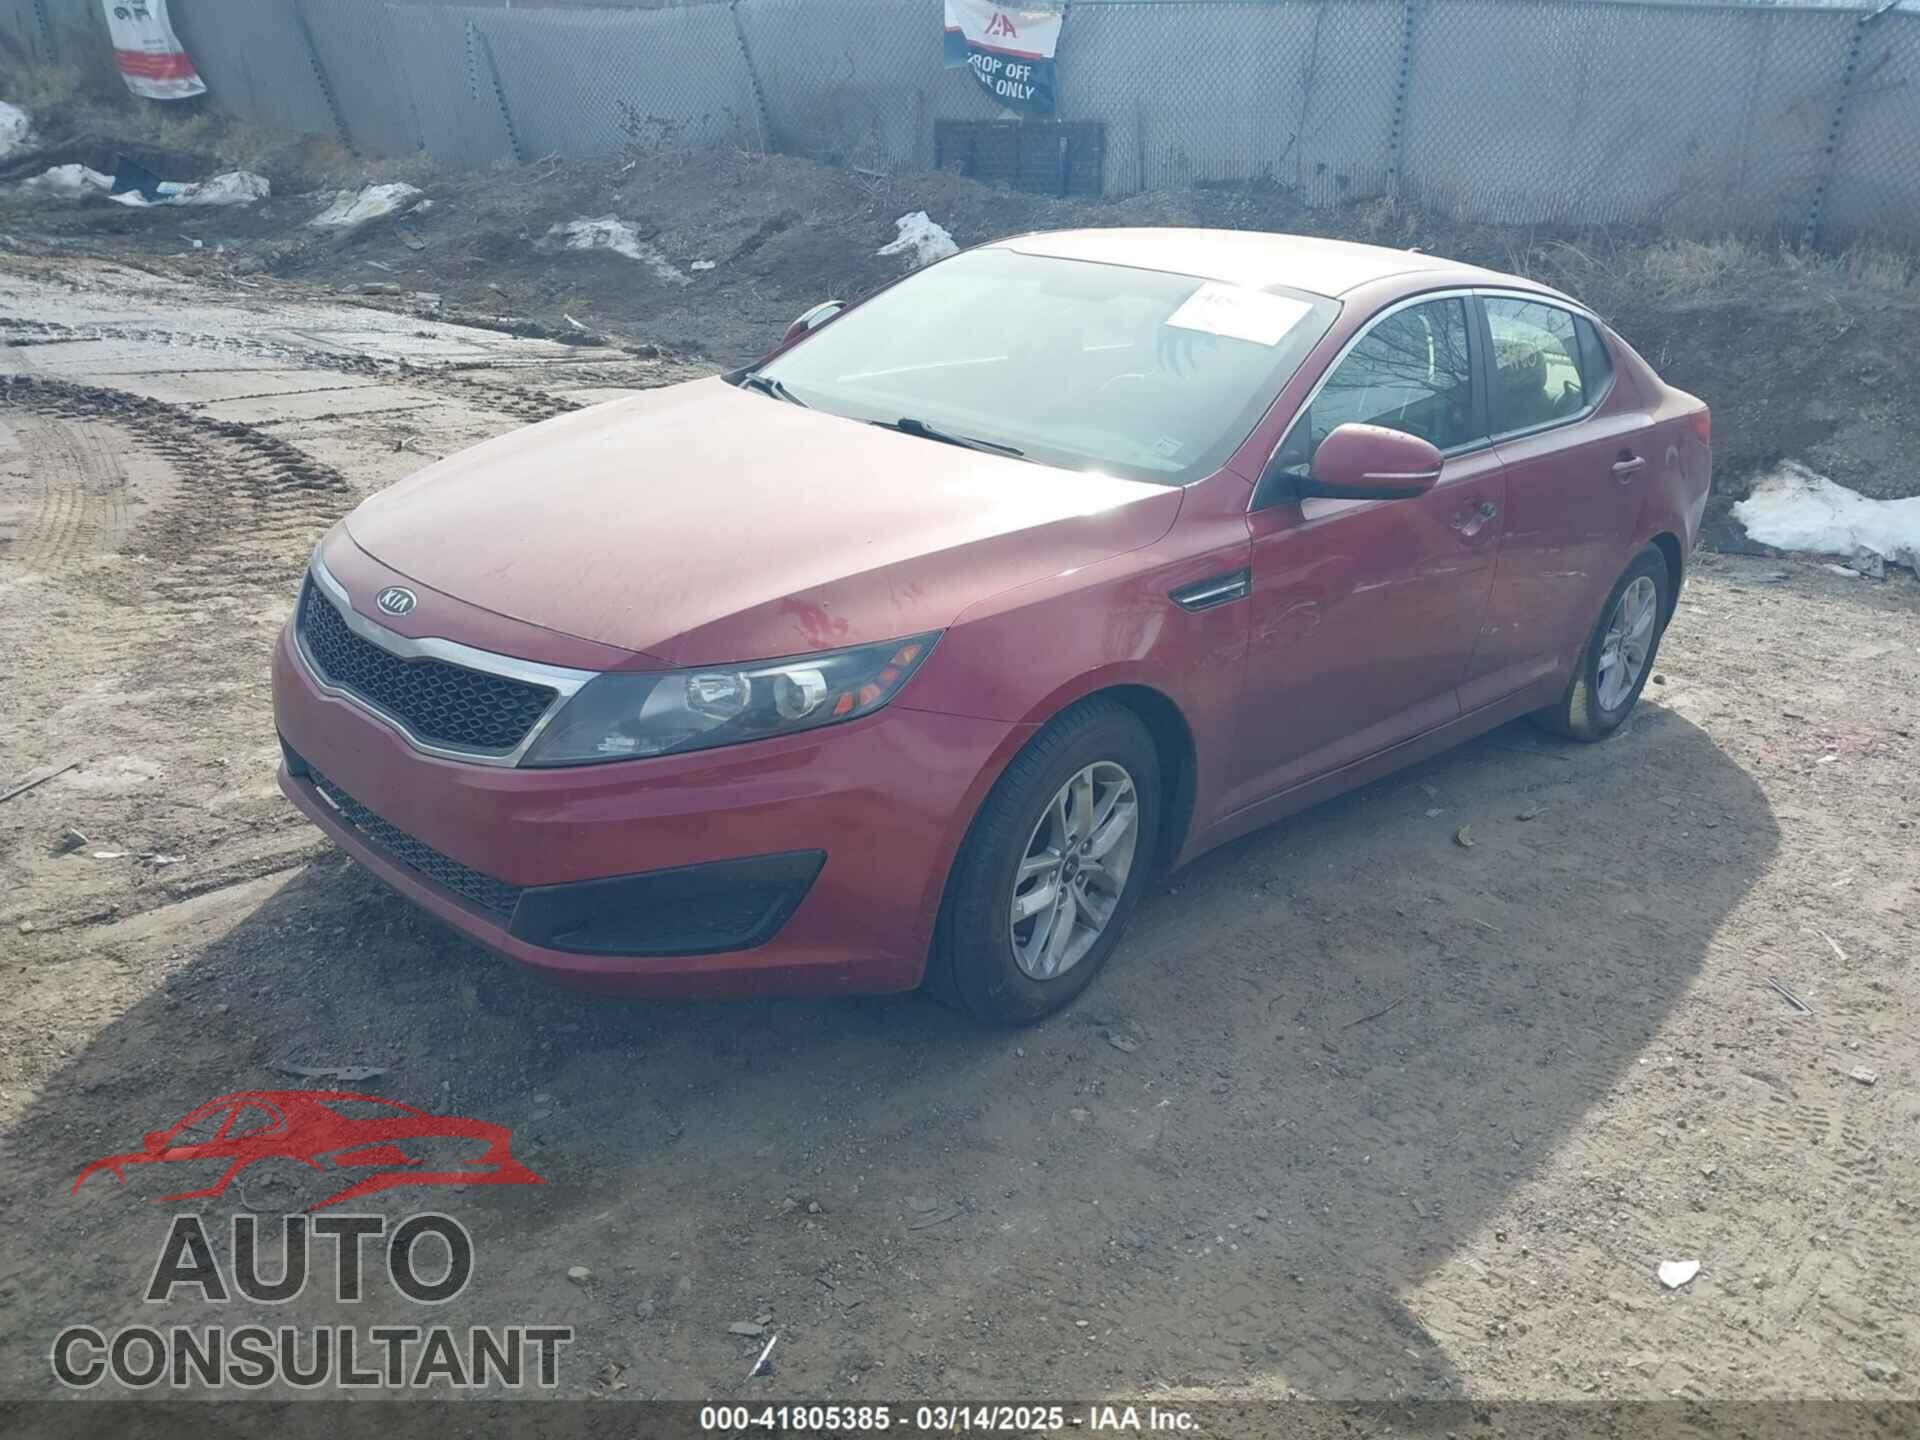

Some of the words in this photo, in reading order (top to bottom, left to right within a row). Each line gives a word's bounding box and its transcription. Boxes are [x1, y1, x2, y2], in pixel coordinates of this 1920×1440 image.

[1005, 63, 1031, 82] OFF
[996, 79, 1035, 100] ONLY
[381, 590, 409, 612] KIA
